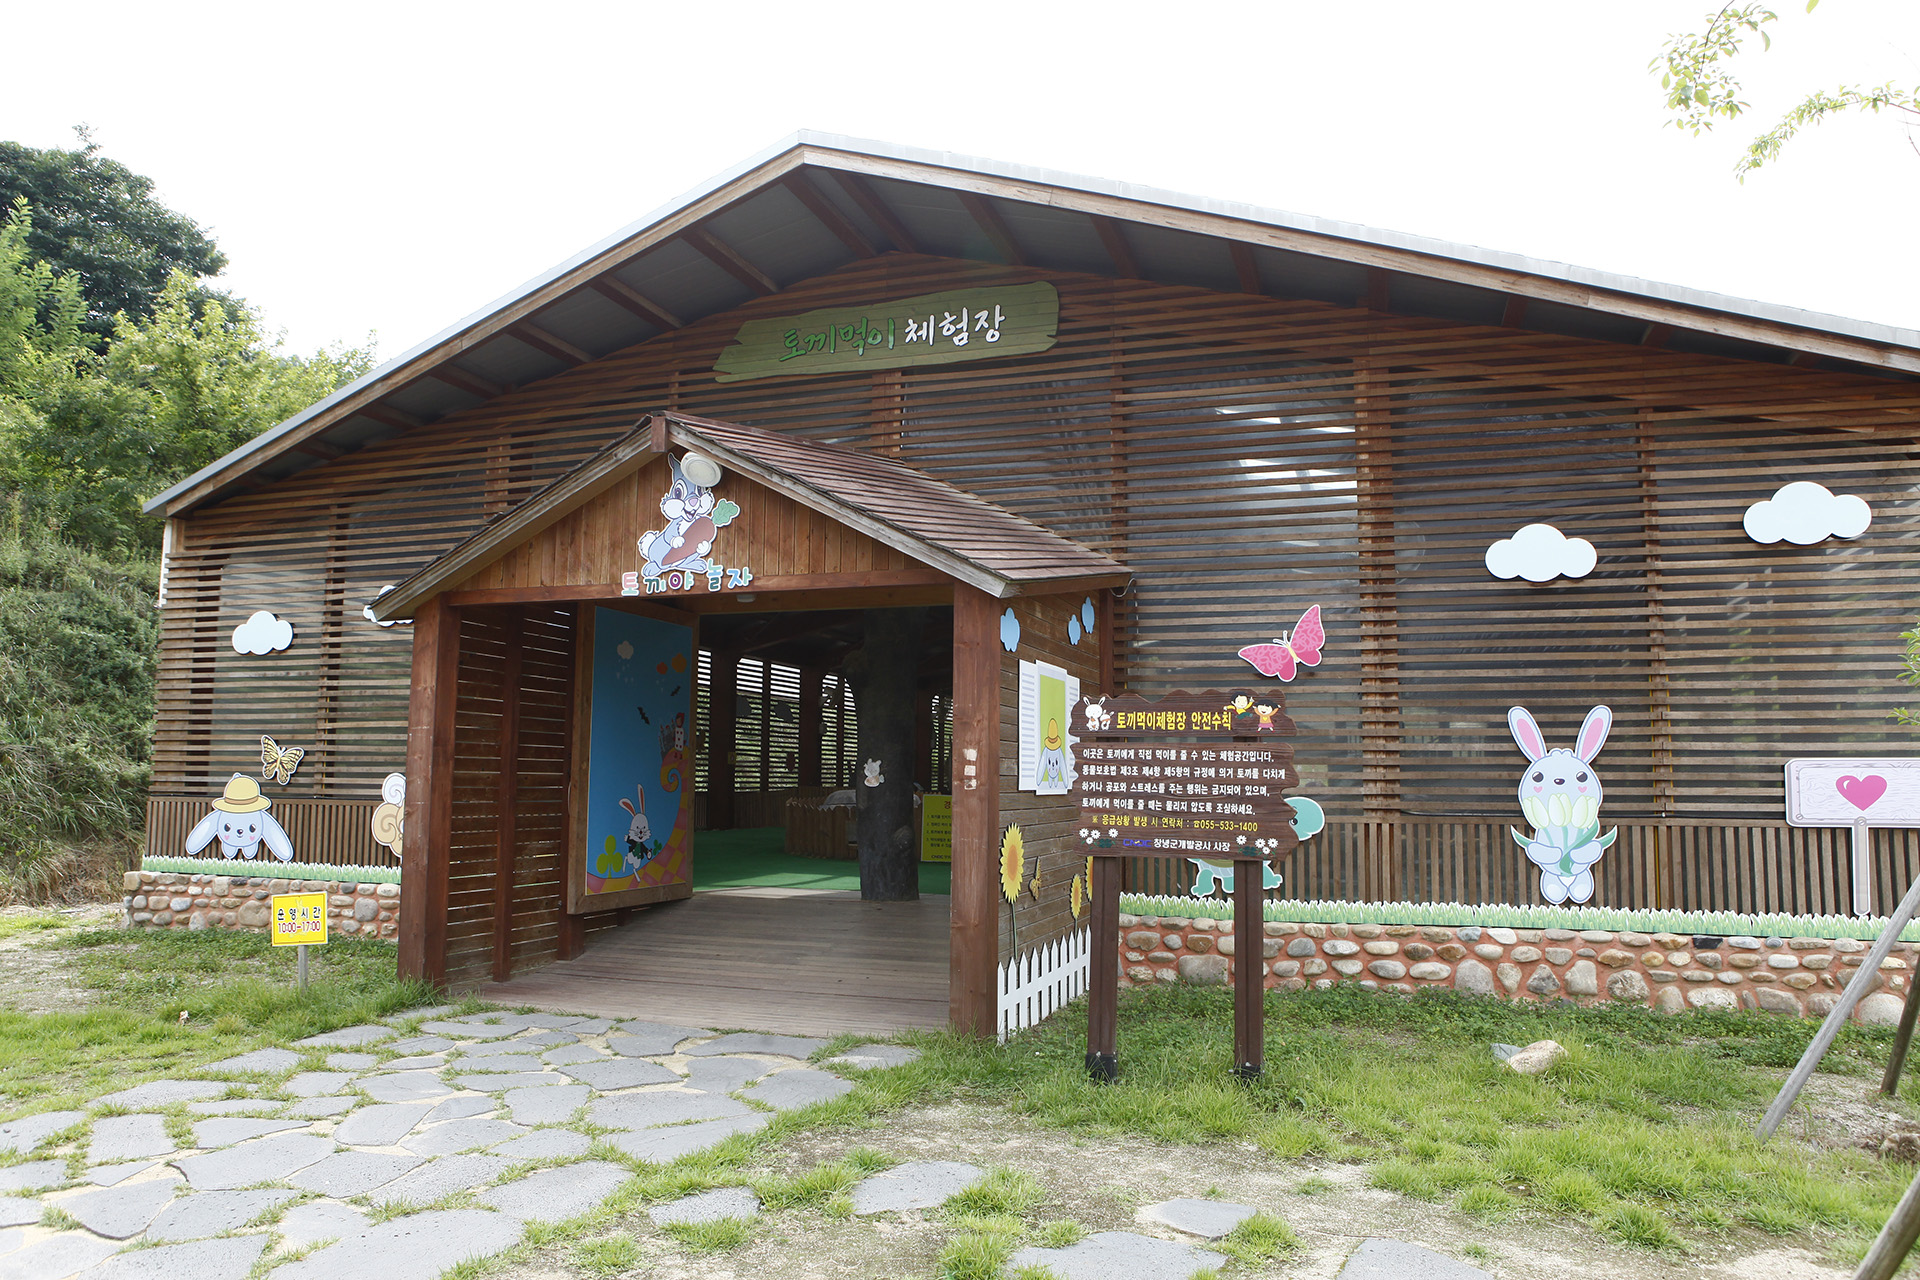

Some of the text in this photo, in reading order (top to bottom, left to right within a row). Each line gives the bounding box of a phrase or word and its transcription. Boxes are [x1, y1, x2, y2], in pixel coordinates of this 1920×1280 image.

[779, 304, 1006, 362] 토끼먹이 체험장
[621, 558, 753, 596] 토끼야 놀자
[1116, 711, 1232, 731] 토끼먹이체험장 안전수칙
[1082, 748, 1275, 763] 이곳은 토끼에게 직접 먹이를 줄 수 있는 체험공간입니다.
[1082, 764, 1286, 780] 동물보호법 제3조 제4항 제5항의 규정에 의거 토끼를 다치게
[1081, 781, 1270, 797] 하거나 공포와 스트레스를 주는 행위는 금지되어 있으며,
[1082, 797, 1256, 816] 토끼에게 먹이를 줄 때는 물리지 않도록 조심하세요.
[1102, 814, 1130, 826] 응급상황
[1133, 816, 1148, 827] 발생
[1151, 817, 1158, 827] 시
[1161, 817, 1184, 829] 연락처
[1153, 838, 1211, 851] 창녕군개발공사
